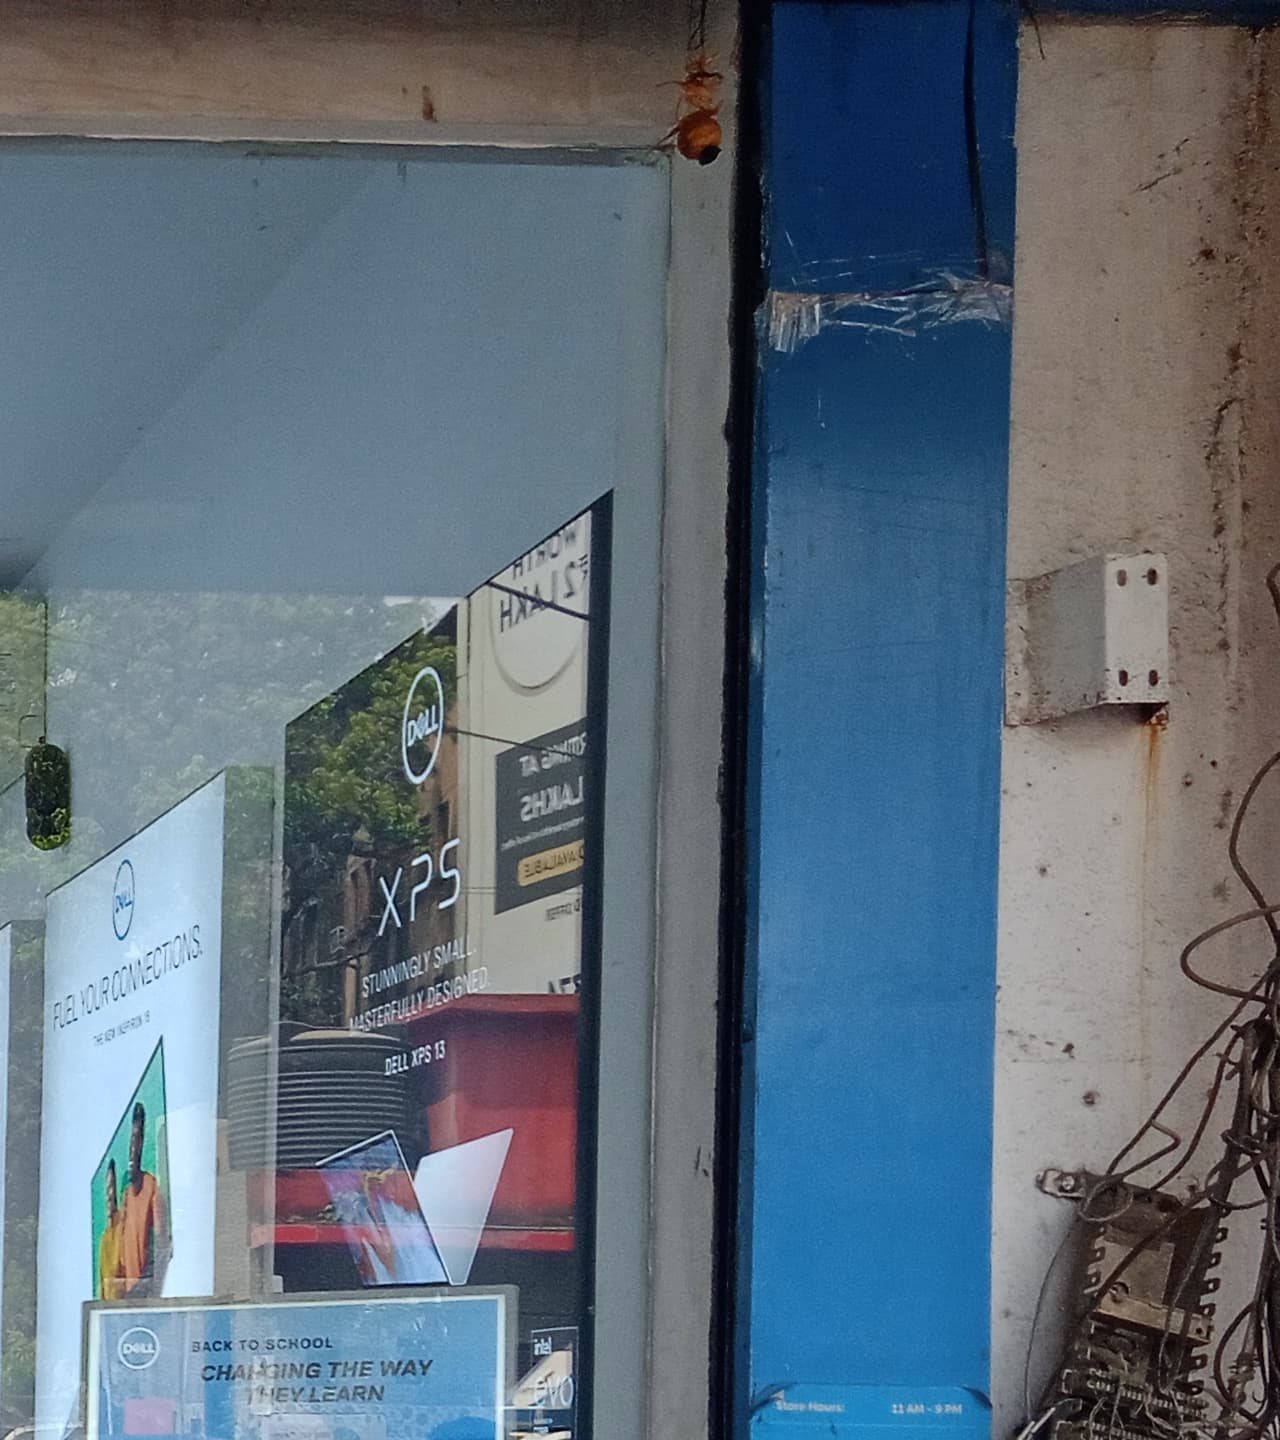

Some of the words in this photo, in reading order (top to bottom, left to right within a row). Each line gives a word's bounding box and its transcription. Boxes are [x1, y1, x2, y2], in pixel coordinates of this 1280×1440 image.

[407, 703, 438, 748] DELL
[377, 838, 460, 936] XPS
[53, 994, 78, 1032] FUEL
[80, 976, 110, 1015] YOUR
[111, 924, 203, 1002] CONNECTIONS.
[362, 950, 431, 998] STUNNINGLY
[349, 989, 425, 1033] MASTERFULLY
[383, 1053, 409, 1076] DELL
[411, 1044, 432, 1067] XPS
[434, 1039, 446, 1060] 13
[193, 1340, 233, 1353] BACK
[240, 1339, 259, 1350] TO
[264, 1337, 334, 1351] SCHOOL
[533, 1336, 552, 1356] intel
[201, 1362, 321, 1382] CHANGING
[328, 1361, 374, 1379] THE
[380, 1359, 434, 1378] WAY
[306, 1385, 386, 1403] LEARN
[776, 1400, 806, 1412] Store
[808, 1401, 845, 1413] Hours:
[892, 1403, 905, 1414] 11
[907, 1404, 925, 1414] AM
[944, 1404, 962, 1415] PM
